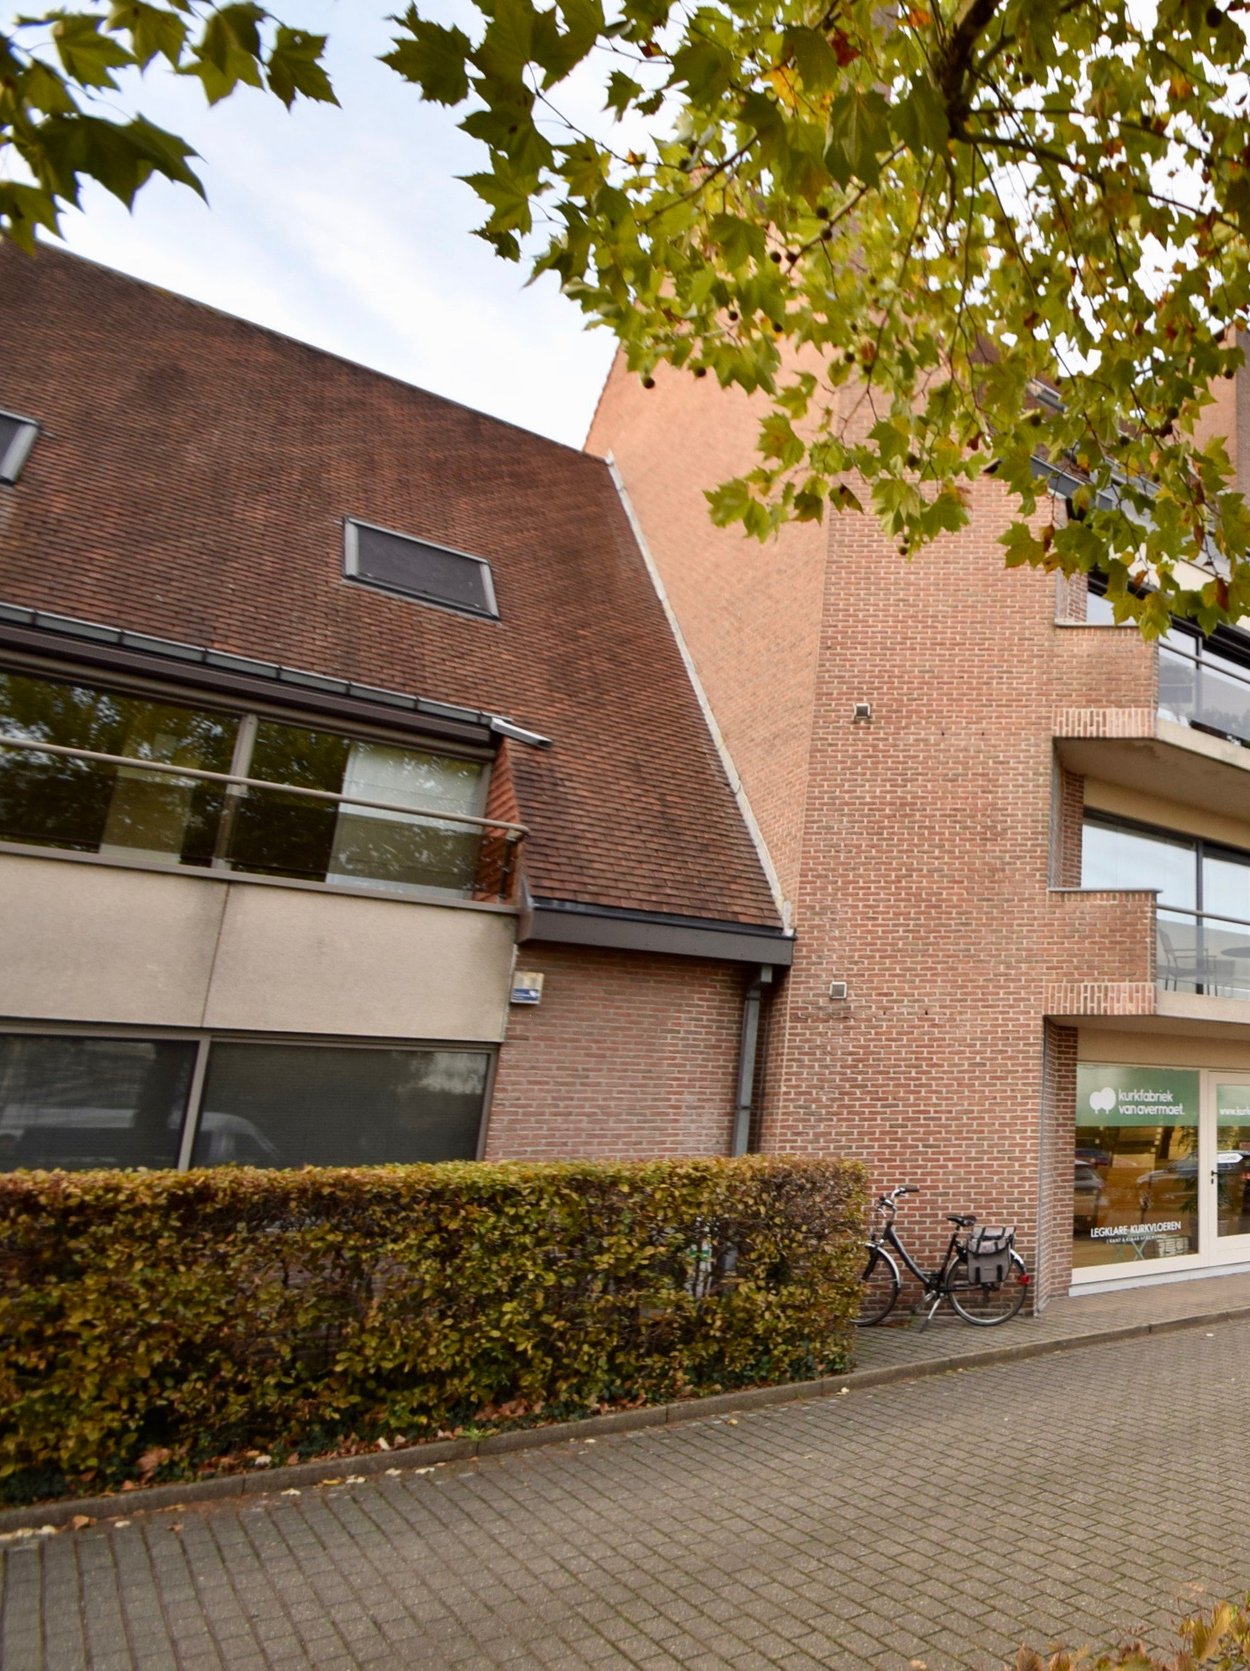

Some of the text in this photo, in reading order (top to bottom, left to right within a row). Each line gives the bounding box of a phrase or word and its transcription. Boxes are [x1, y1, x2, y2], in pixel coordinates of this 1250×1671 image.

[1118, 1089, 1173, 1102] kurkfabriek
[1090, 1225, 1128, 1238] LEGKLARE
[1130, 1221, 1182, 1234] KURKVLOEREN
